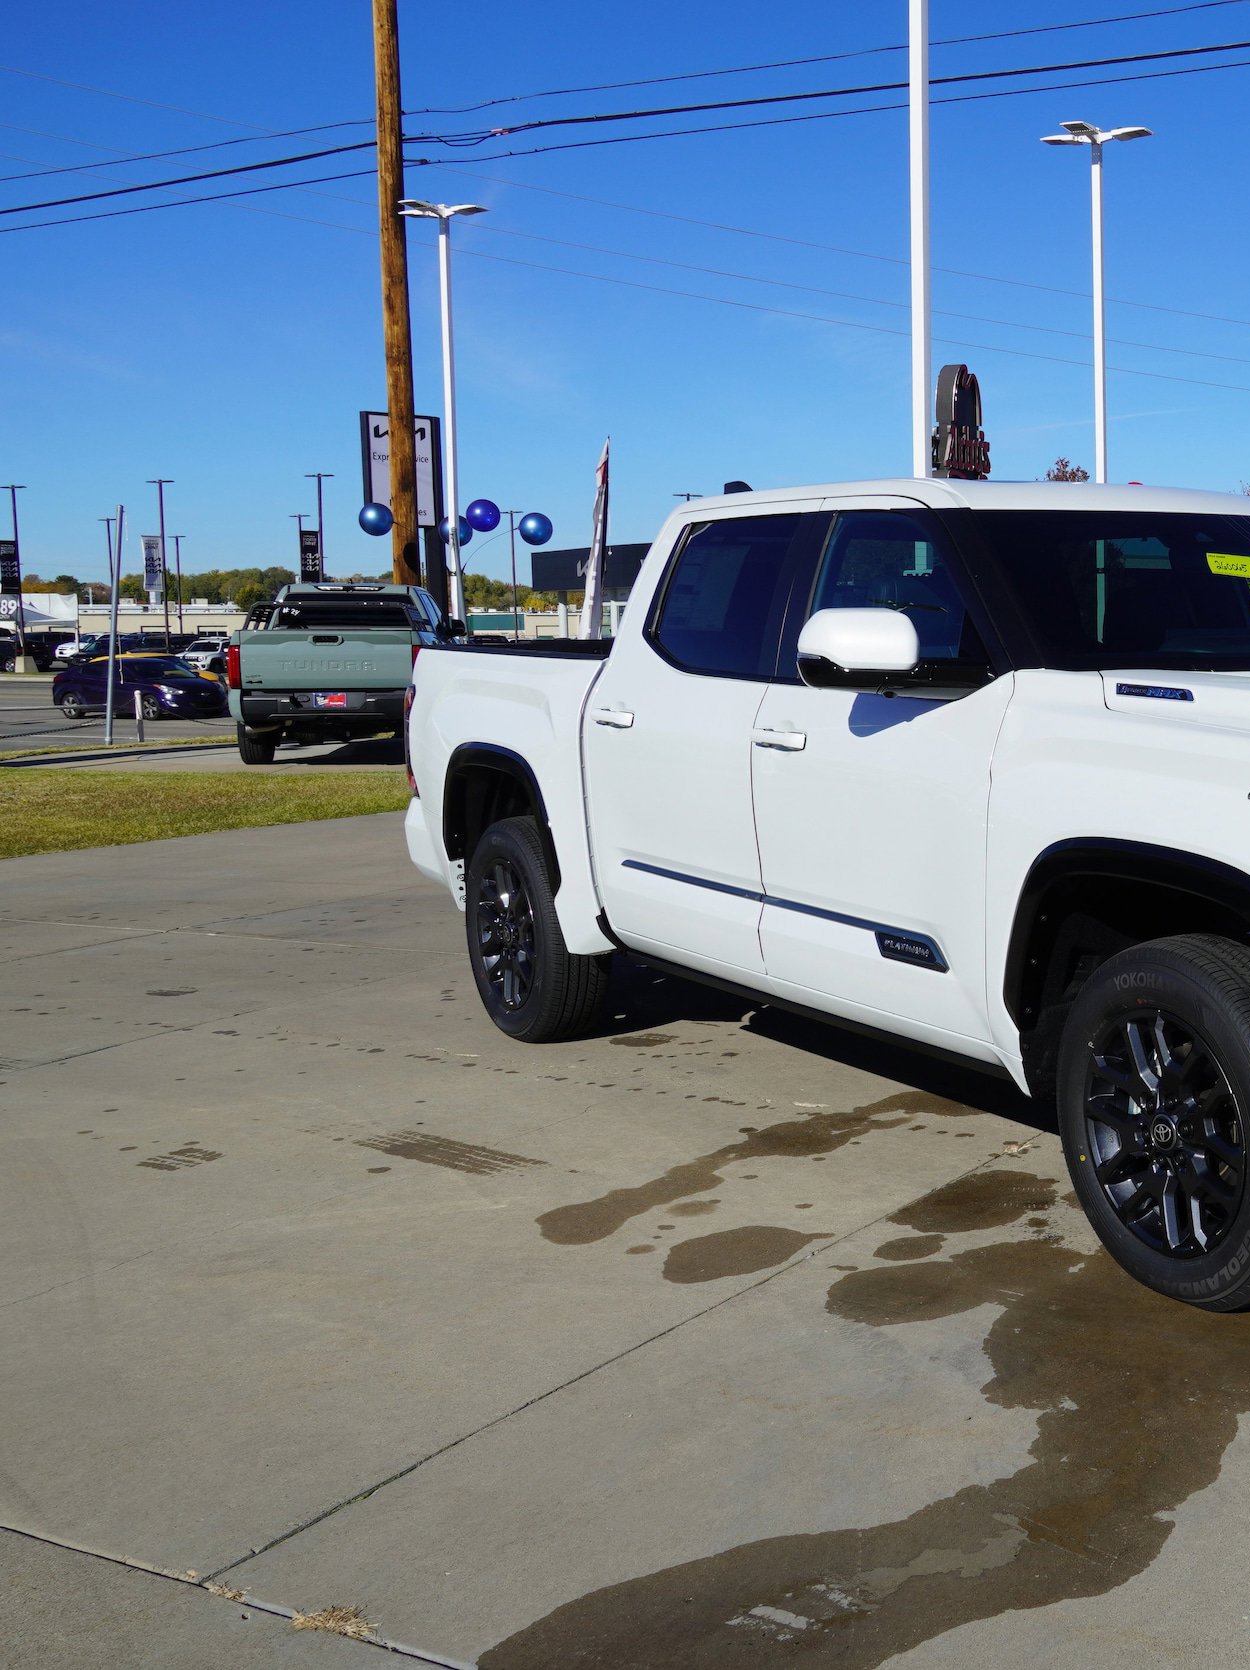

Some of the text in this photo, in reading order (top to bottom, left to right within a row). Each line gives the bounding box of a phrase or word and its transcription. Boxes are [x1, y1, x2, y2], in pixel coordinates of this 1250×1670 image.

[278, 660, 377, 672] TUNDRA
[884, 939, 930, 957] PLATINUM
[1113, 971, 1168, 992] YOKOHA
